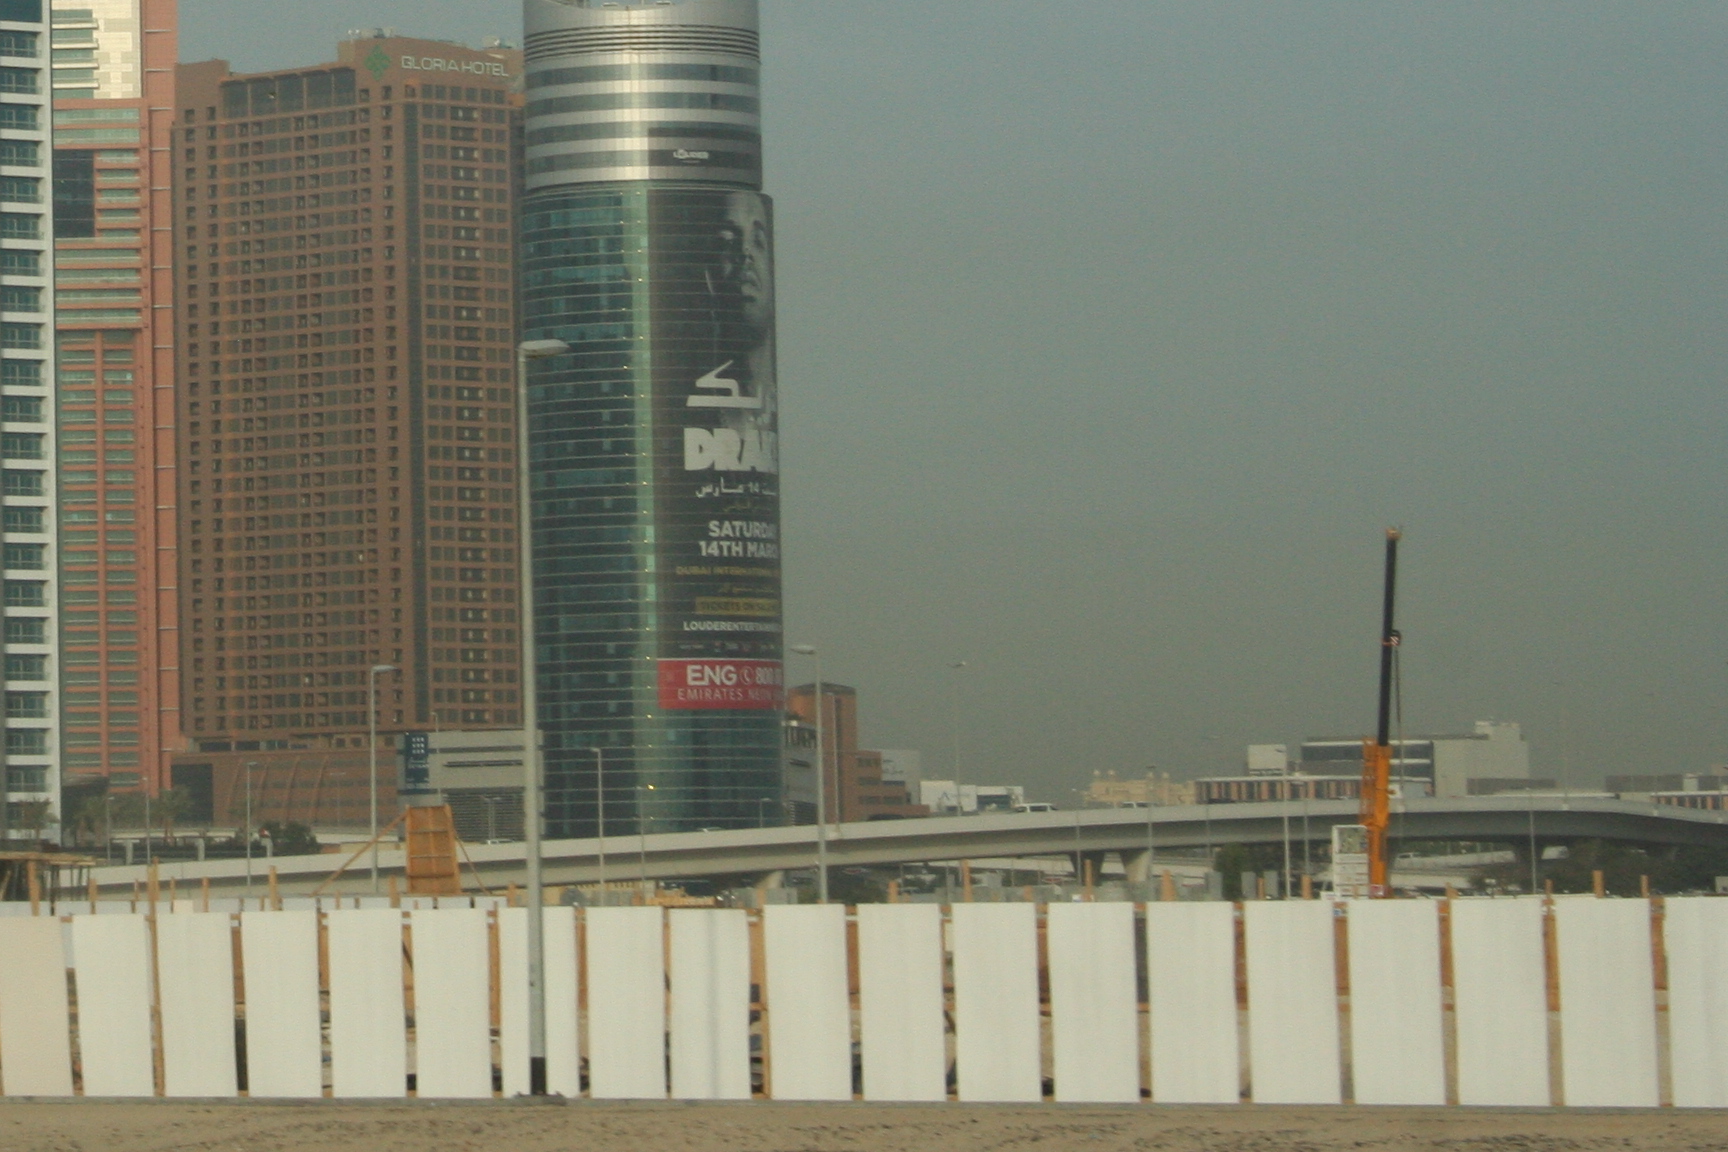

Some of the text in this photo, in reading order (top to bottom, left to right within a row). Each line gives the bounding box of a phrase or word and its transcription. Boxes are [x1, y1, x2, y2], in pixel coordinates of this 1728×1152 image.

[401, 55, 509, 77] GLORIA HOTEL
[683, 427, 778, 475] DRAK
[698, 540, 745, 558] 14TH
[686, 664, 738, 686] ENG
[677, 688, 744, 701] EMIRATES
